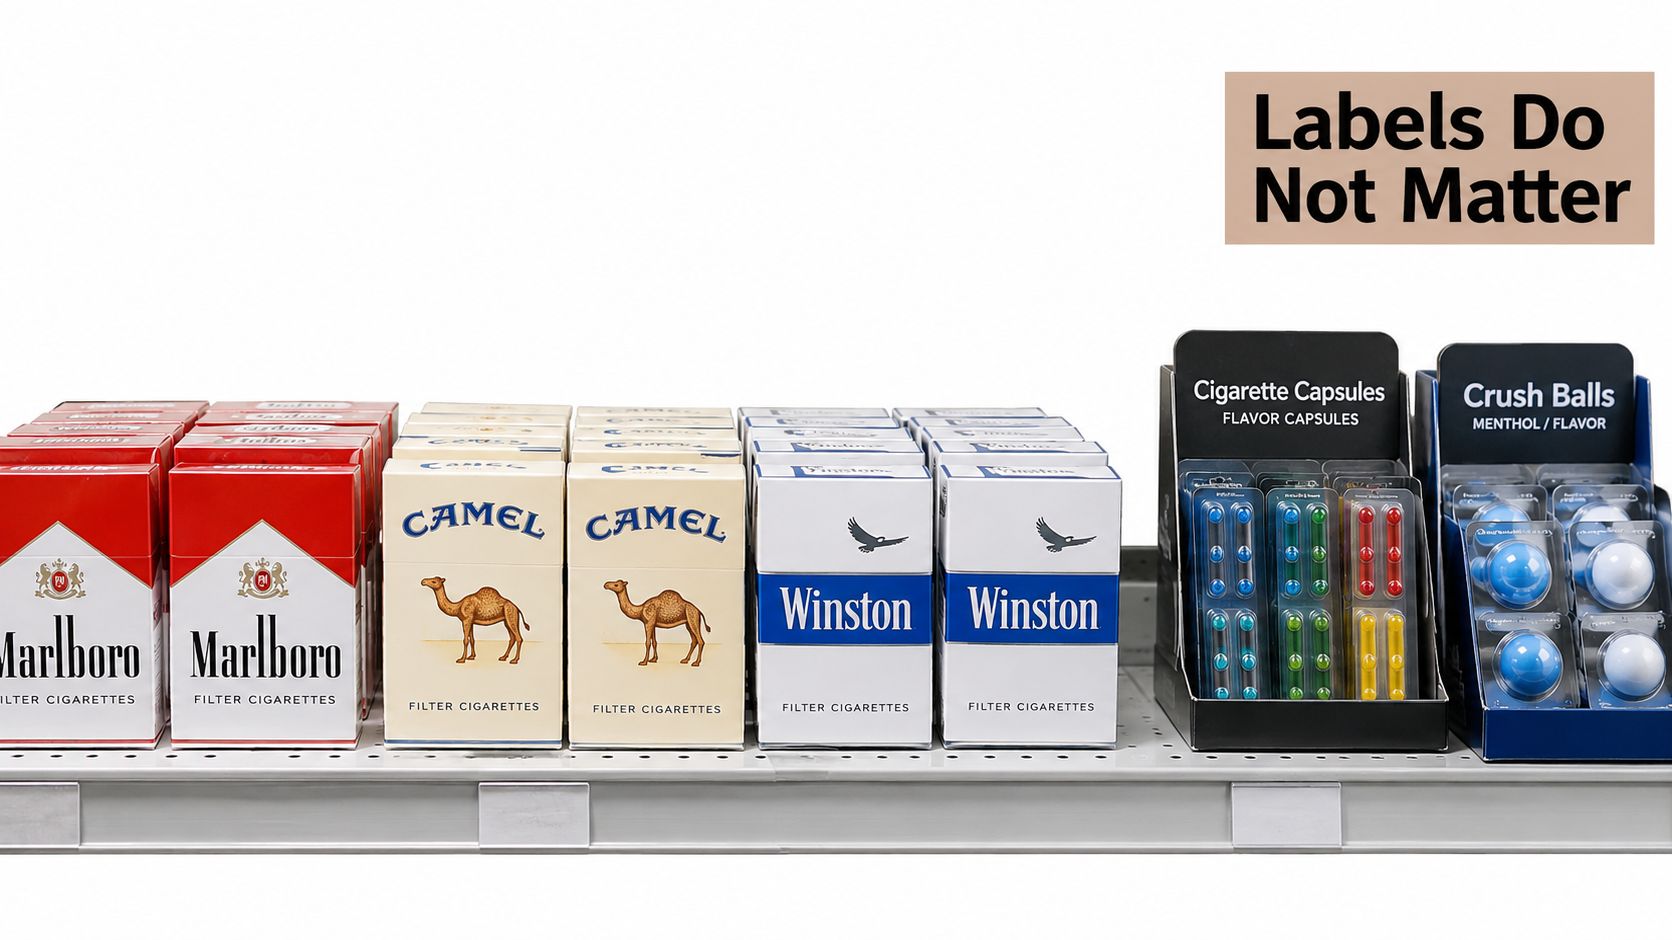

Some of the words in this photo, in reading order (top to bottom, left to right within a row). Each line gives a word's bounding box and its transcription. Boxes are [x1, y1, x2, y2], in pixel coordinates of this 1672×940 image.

[1193, 379, 1289, 405] Cigarette
[1294, 380, 1386, 406] Capsules
[1463, 382, 1544, 408] Crush
[1552, 381, 1616, 408] Balls
[1223, 411, 1280, 425] FLAVOR
[1284, 412, 1360, 426] CAPSULES
[1472, 417, 1541, 430] MENTHOL
[1552, 416, 1607, 430] FLAVOR
[402, 501, 546, 540] CAMEL
[585, 505, 728, 544] CAMEL
[779, 586, 913, 631] Winston
[967, 586, 1100, 630] Winston
[0, 614, 140, 679] Marlboro
[189, 614, 342, 679] Marlboro
[0, 695, 40, 705] ILTER
[46, 694, 135, 705] CIGARETTES
[194, 694, 241, 705] FILTER
[248, 695, 336, 705] CIGARETTES
[409, 701, 453, 711] FILTER
[459, 701, 540, 712] CIGARETTES
[593, 704, 636, 714] FILTER
[641, 704, 721, 714] CIGARETTES
[782, 703, 825, 712] FILTER
[830, 703, 909, 713] CIGARETTES
[968, 702, 1011, 711] FILTER
[1016, 702, 1095, 712] CIGARETTES
